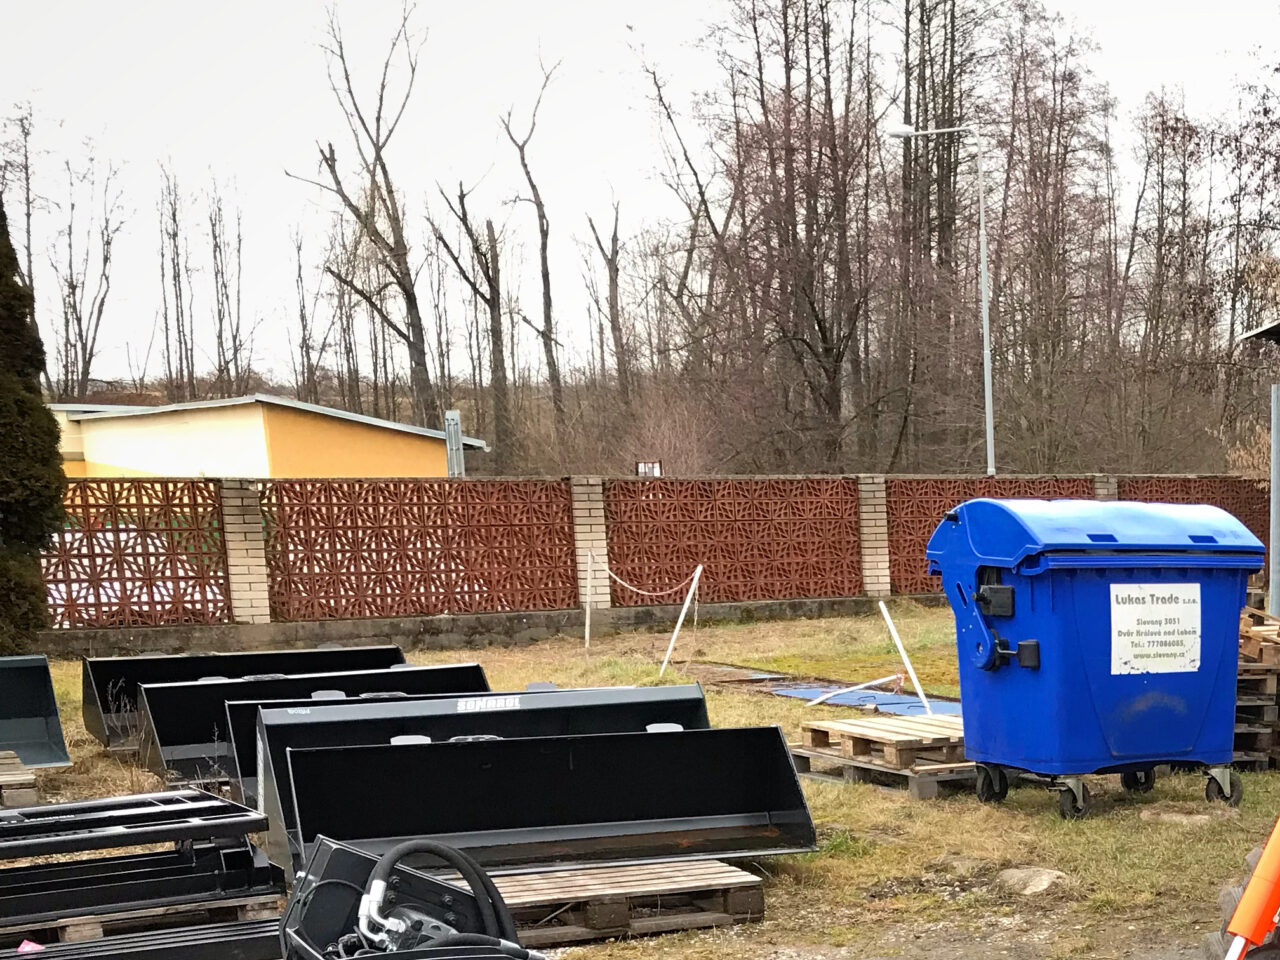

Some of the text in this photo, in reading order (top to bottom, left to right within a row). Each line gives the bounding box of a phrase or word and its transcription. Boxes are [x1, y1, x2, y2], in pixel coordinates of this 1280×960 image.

[1115, 594, 1146, 605] Lukas
[1149, 594, 1180, 605] Trade
[1136, 619, 1162, 627] Slovany
